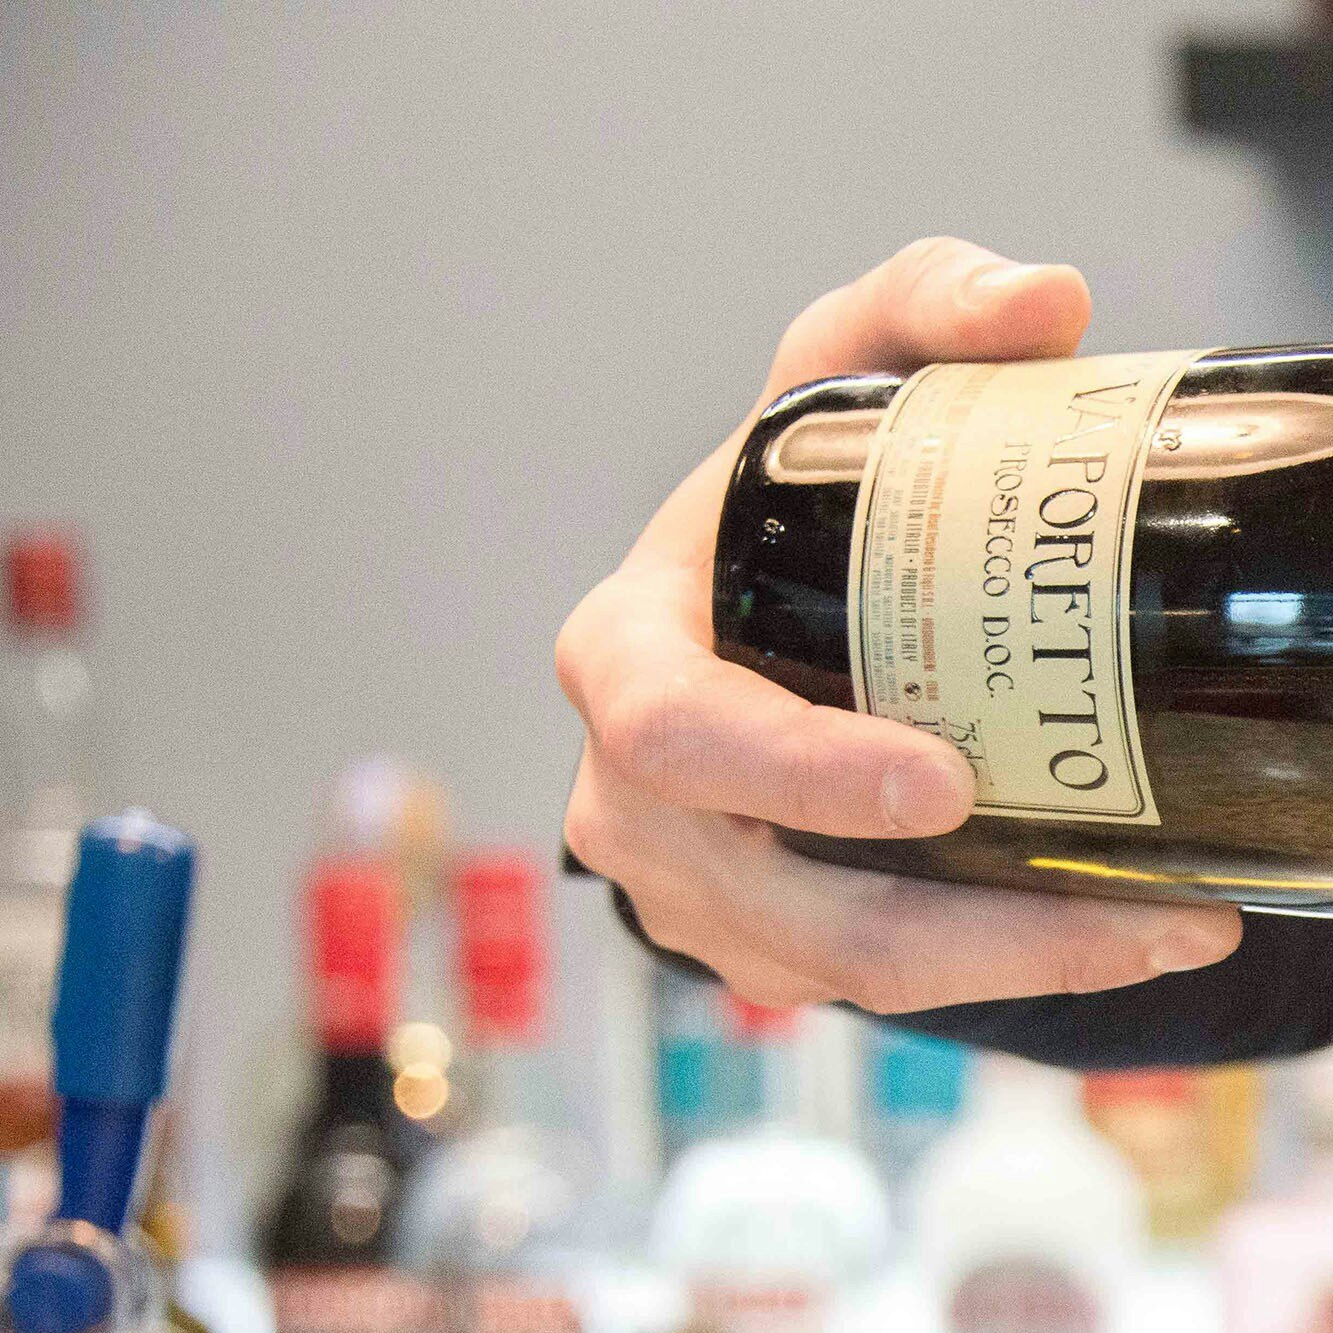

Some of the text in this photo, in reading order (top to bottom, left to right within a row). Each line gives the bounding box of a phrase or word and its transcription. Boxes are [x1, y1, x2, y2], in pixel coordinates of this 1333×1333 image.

[903, 523, 923, 555] ITALIA
[982, 440, 1032, 699] PROSECCO D.O.C.
[1025, 379, 1141, 790] VAPORETTO
[899, 568, 919, 613] PRODUCT
[900, 617, 918, 629] OF
[900, 633, 919, 663] ITALY
